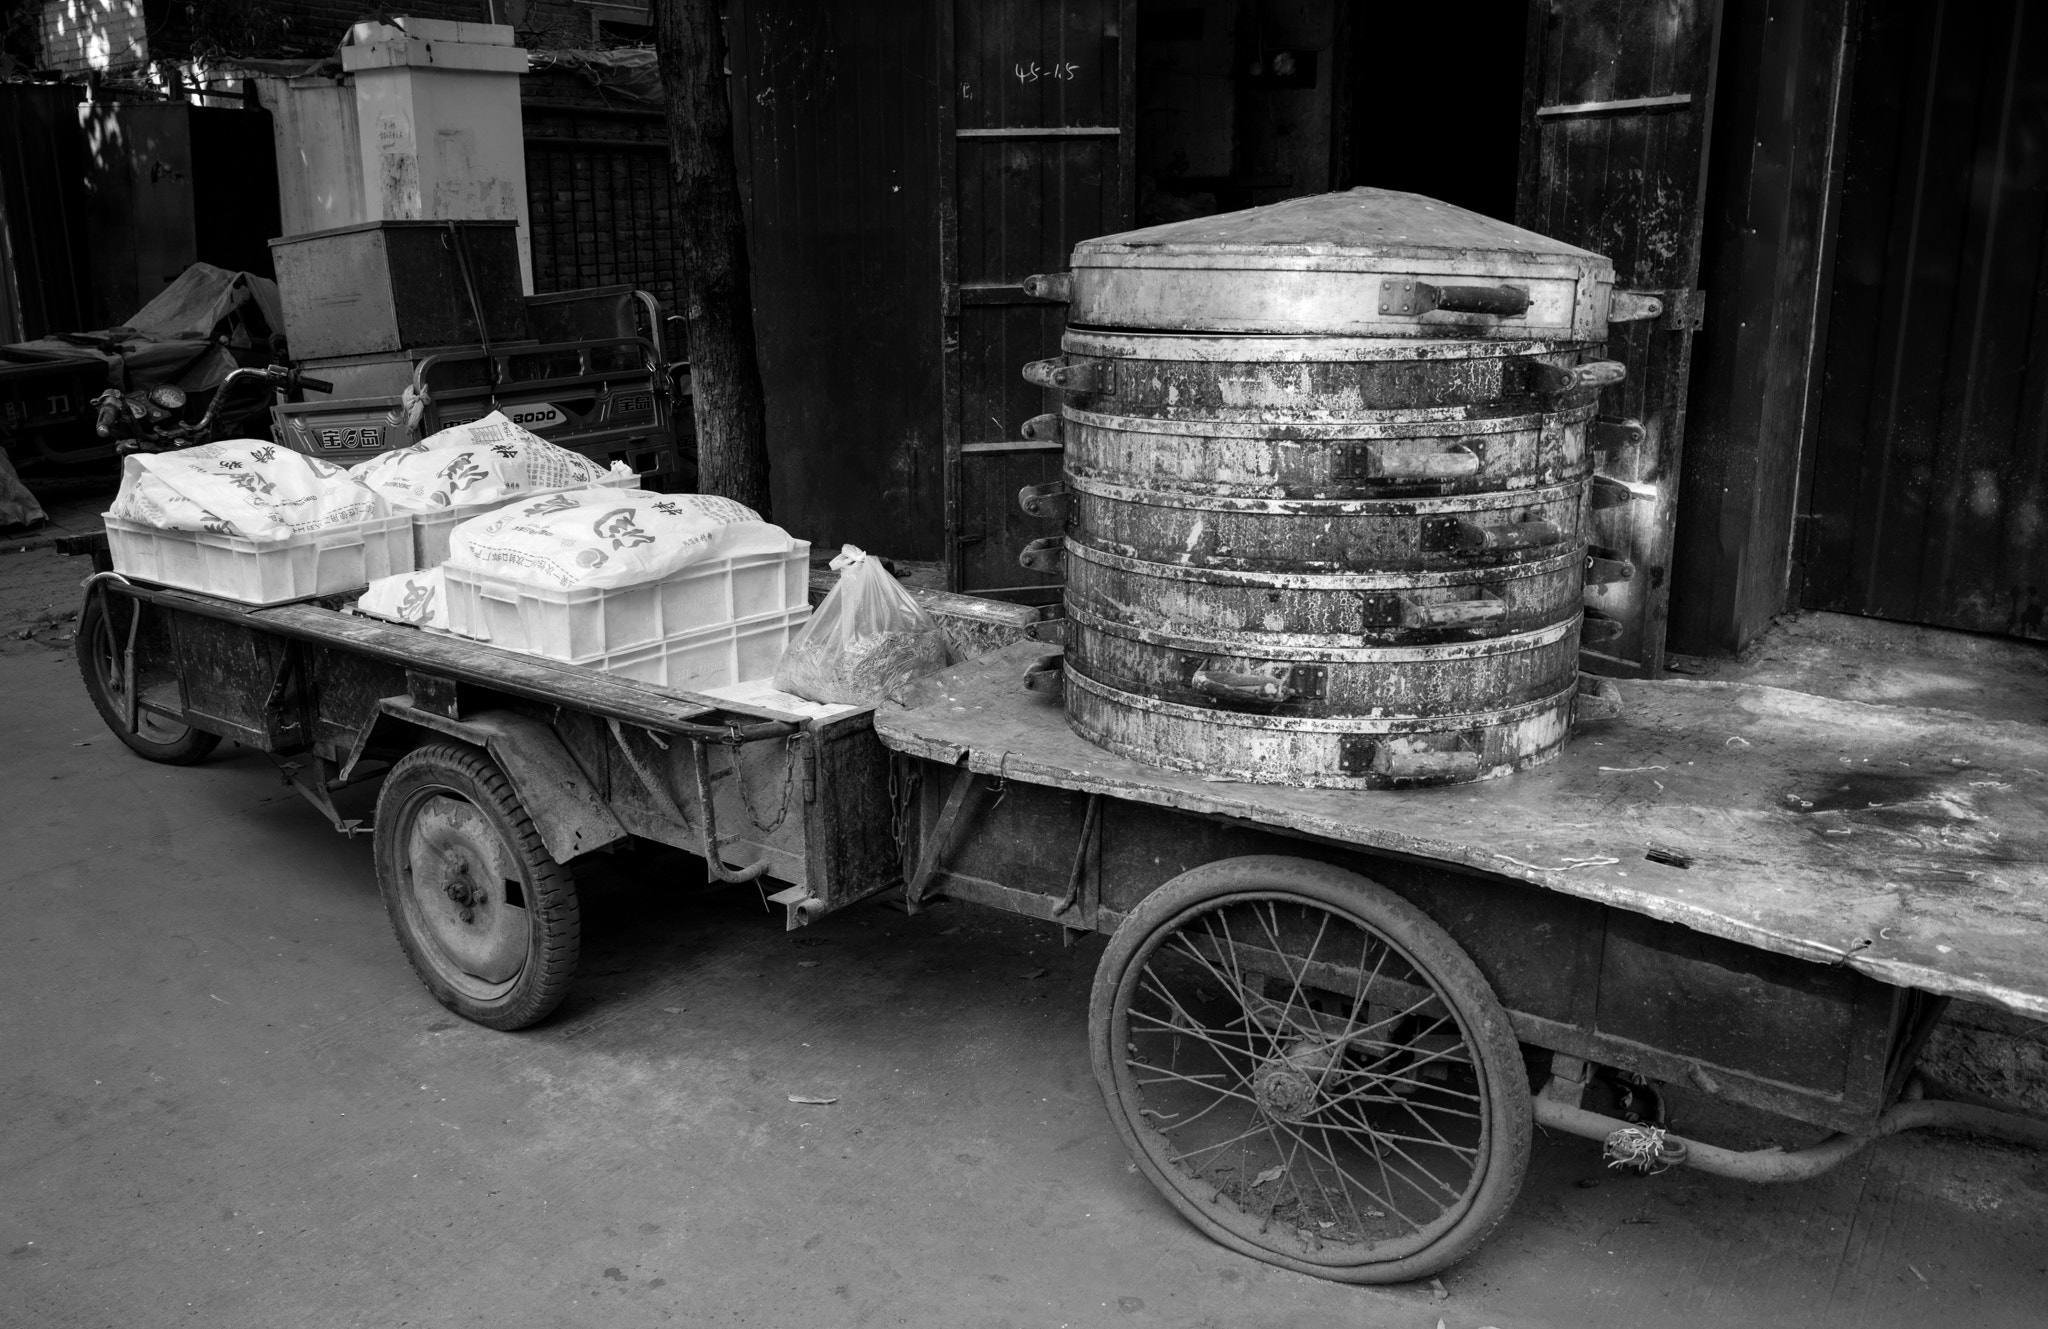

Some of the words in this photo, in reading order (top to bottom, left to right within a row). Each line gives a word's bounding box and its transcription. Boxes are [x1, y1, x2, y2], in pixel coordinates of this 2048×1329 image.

[619, 395, 650, 411] 宝岛
[513, 410, 556, 424] BODO
[321, 428, 380, 448] 宝岛
